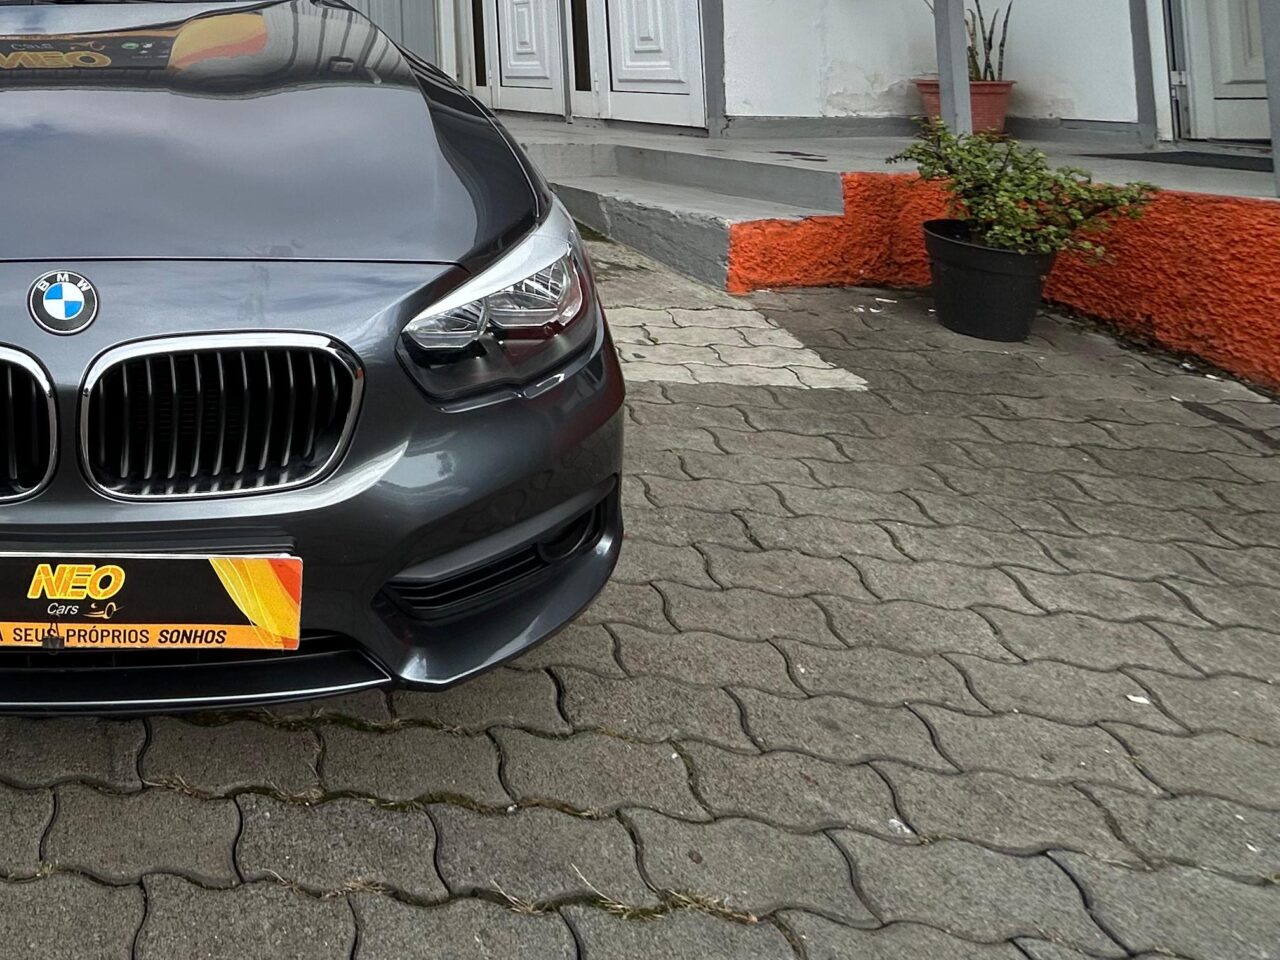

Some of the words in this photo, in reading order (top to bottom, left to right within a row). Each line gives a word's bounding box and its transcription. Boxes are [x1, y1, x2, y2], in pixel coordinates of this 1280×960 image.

[36, 272, 92, 292] BMW
[27, 563, 126, 600] NEO
[46, 602, 80, 615] Cars
[65, 625, 149, 644] PRÓPRIOS
[157, 629, 227, 644] SONHOS
